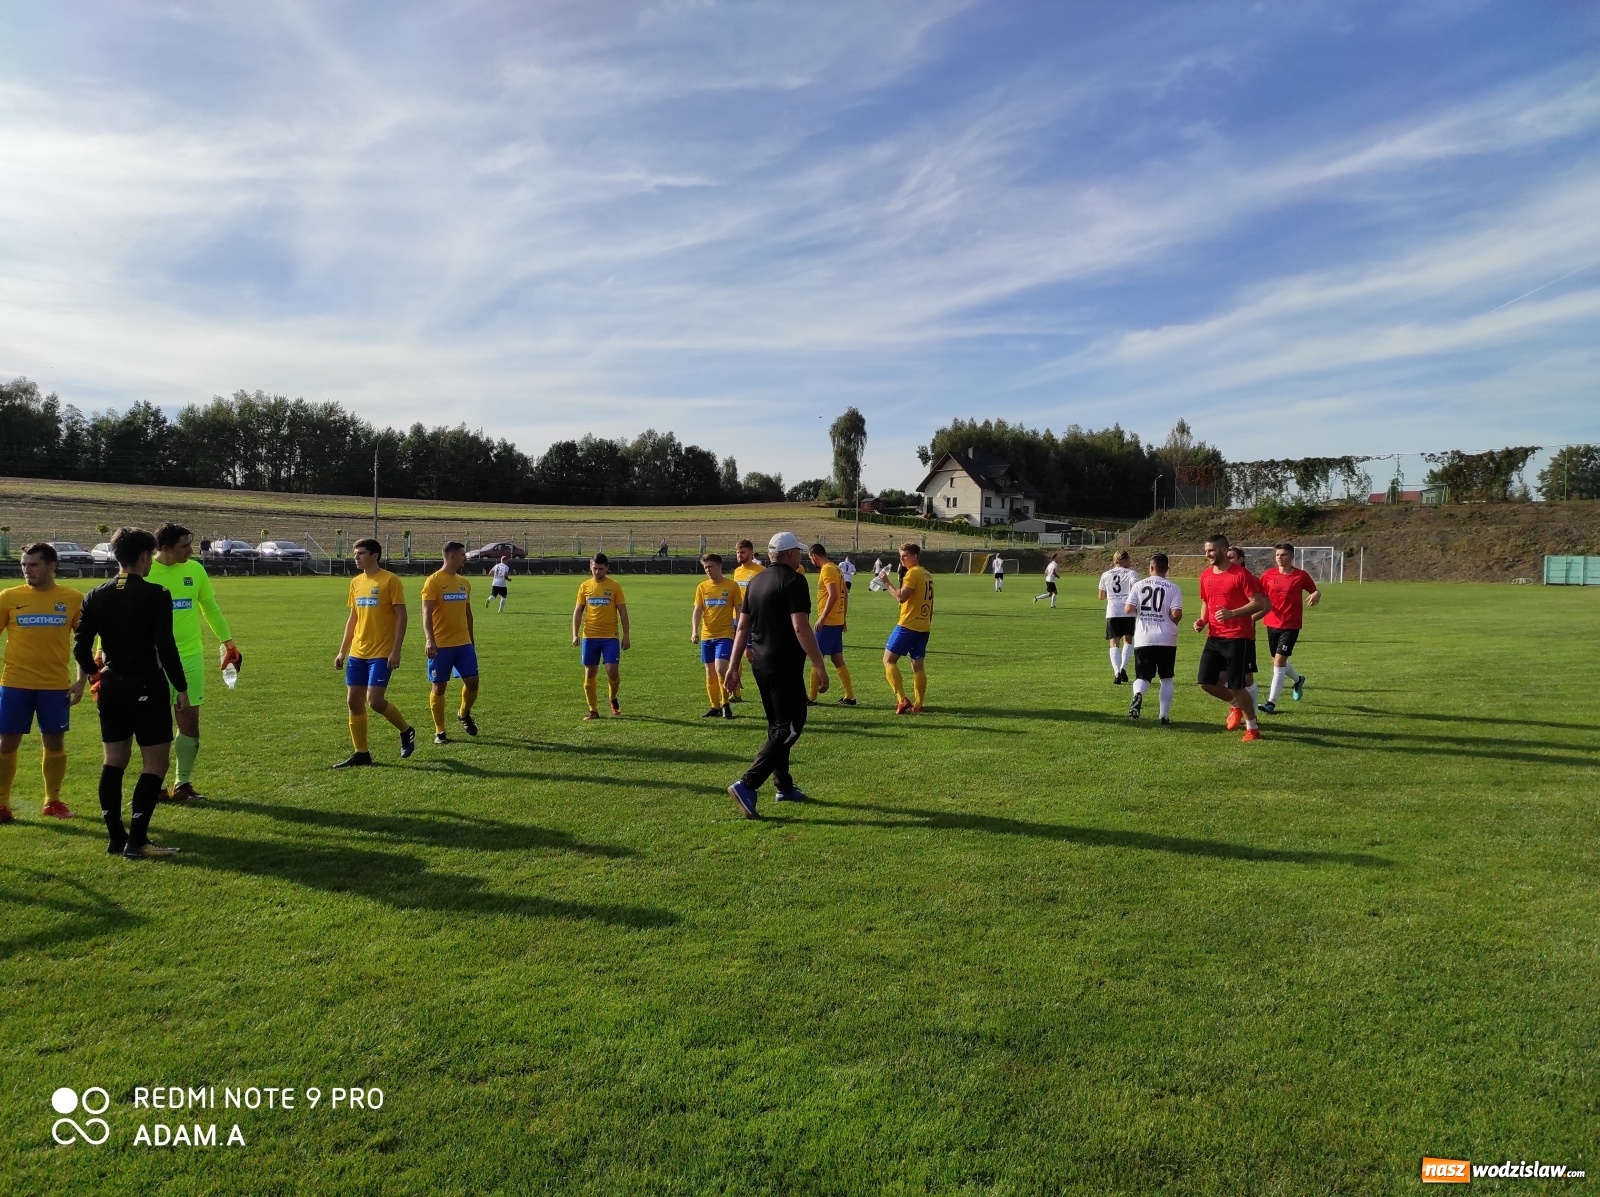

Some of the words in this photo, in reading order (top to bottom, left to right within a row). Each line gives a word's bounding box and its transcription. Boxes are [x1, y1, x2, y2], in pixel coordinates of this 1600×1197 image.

[924, 580, 934, 601] 15
[1113, 574, 1122, 594] 3
[1140, 585, 1166, 613] 20
[17, 616, 67, 624] DECATHLON
